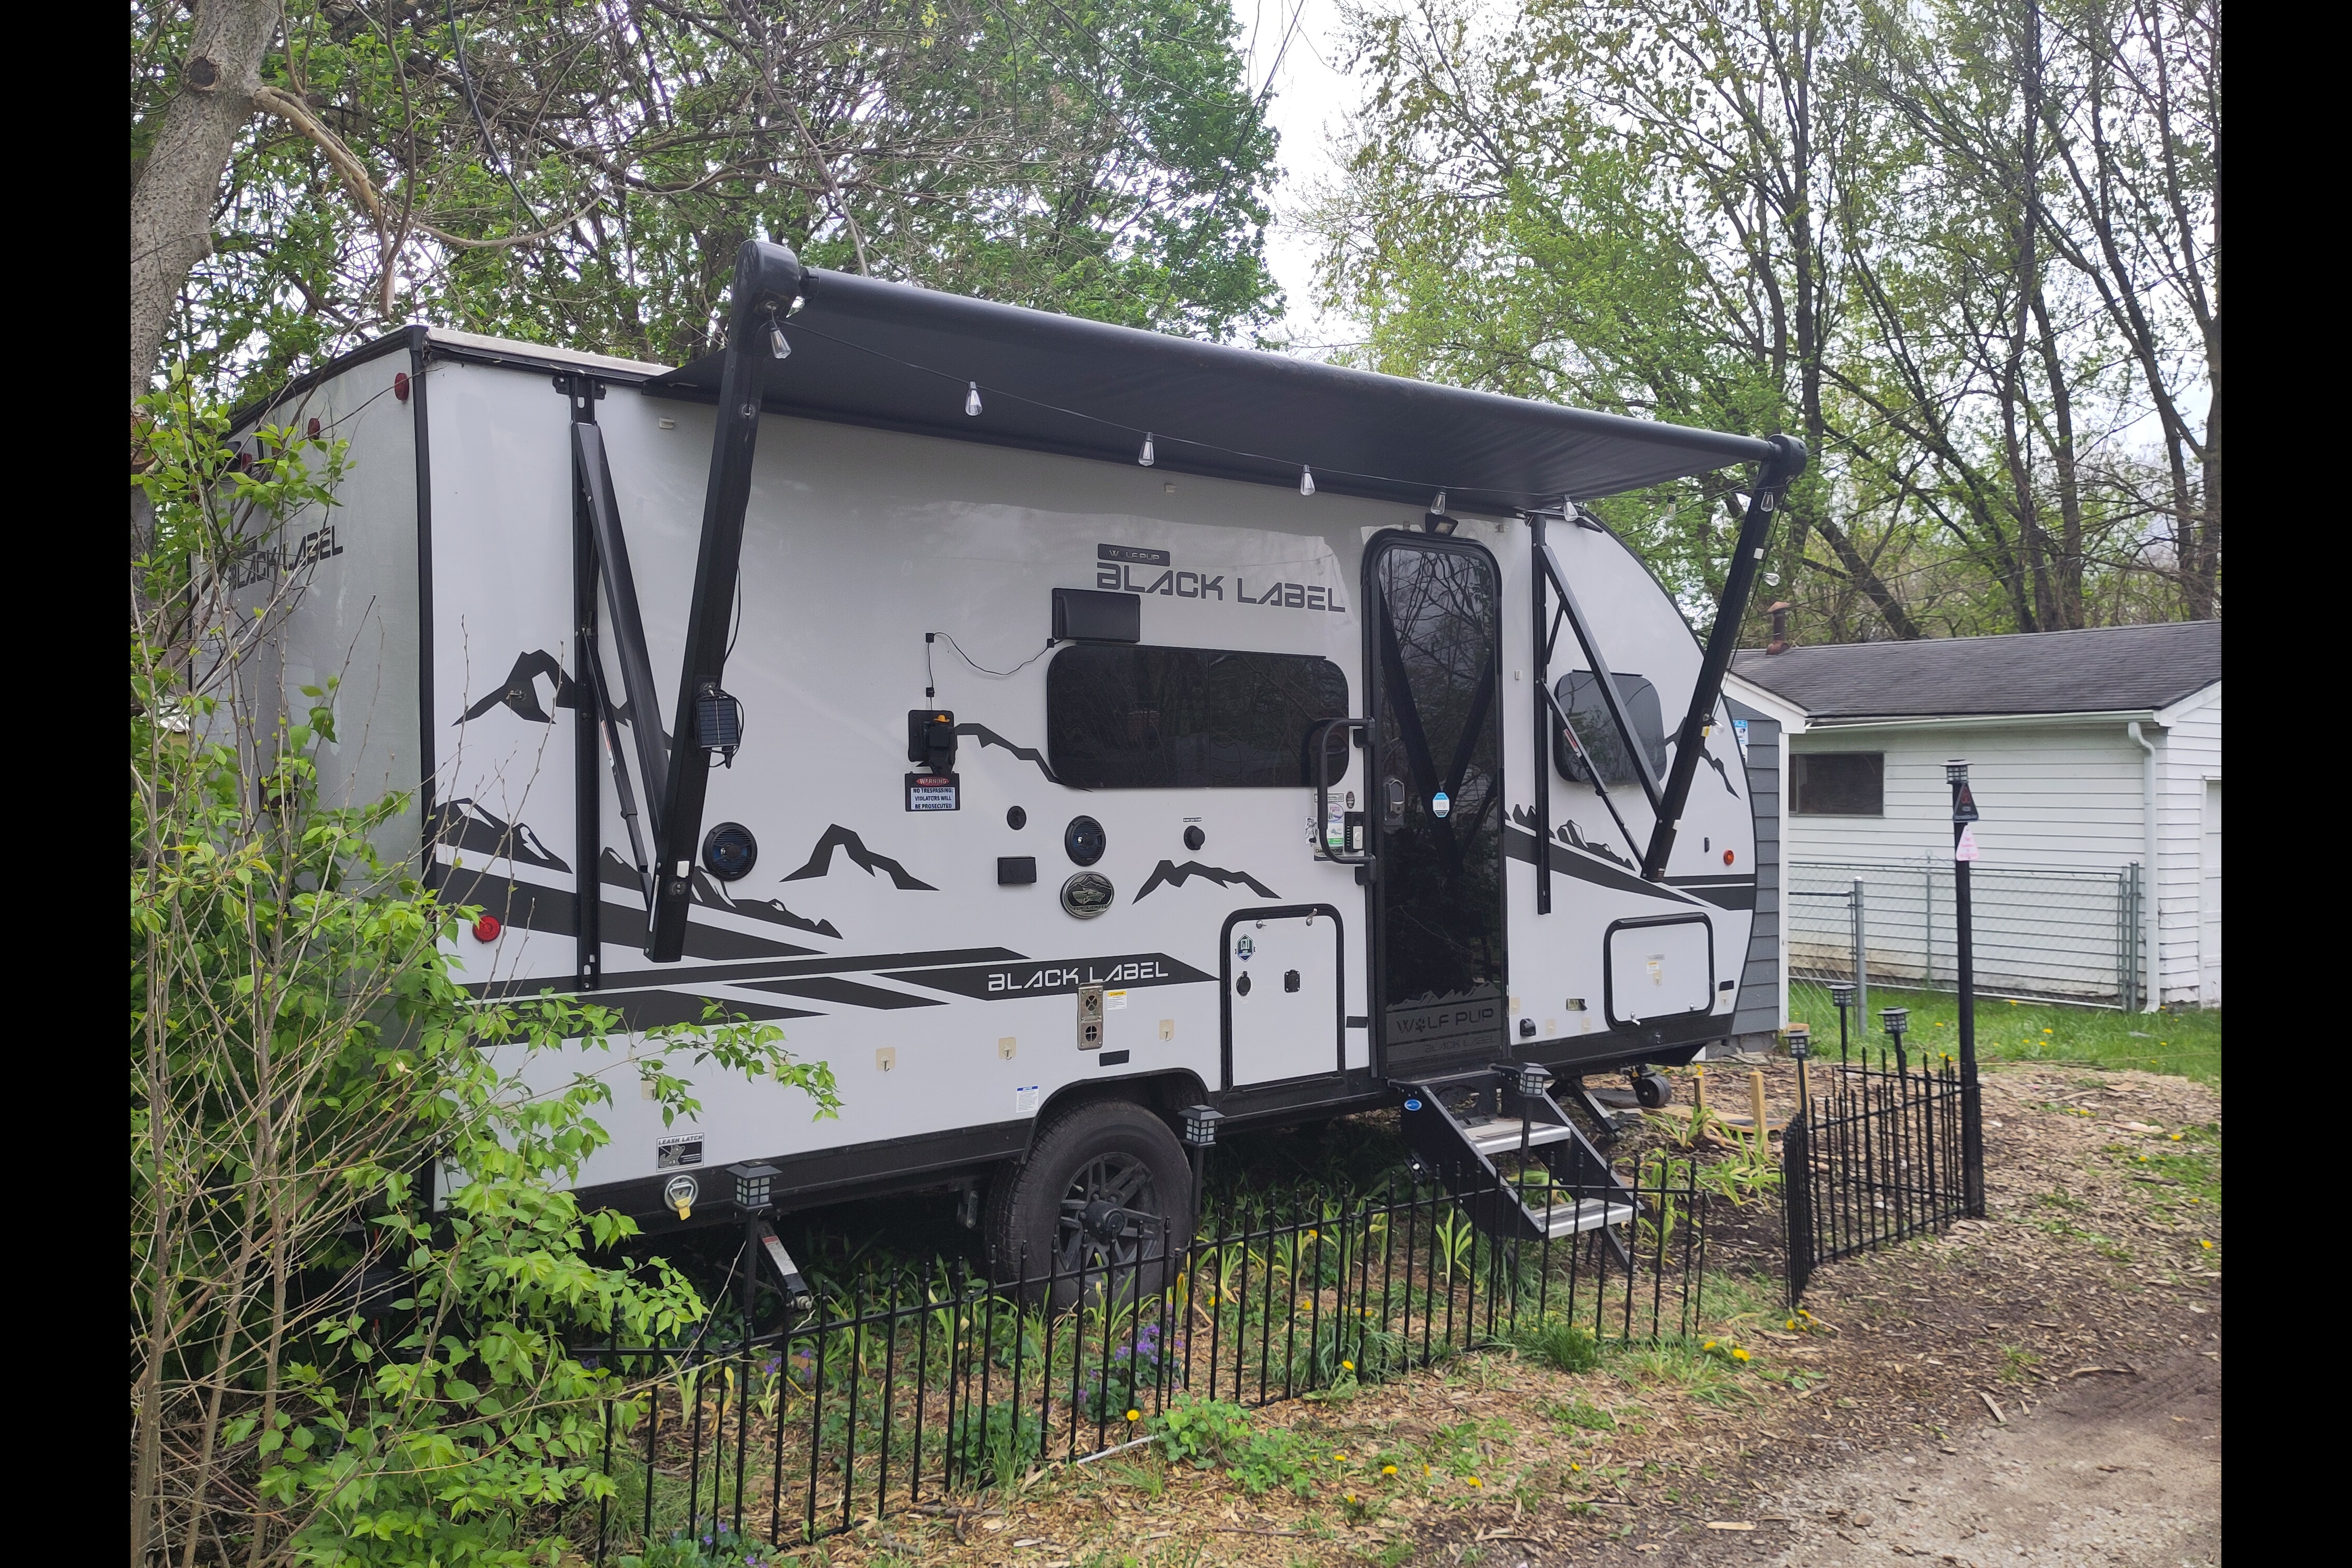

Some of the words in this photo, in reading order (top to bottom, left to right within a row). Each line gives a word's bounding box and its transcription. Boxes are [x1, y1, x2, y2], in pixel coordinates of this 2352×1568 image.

[283, 525, 343, 572] LABEL
[1109, 549, 1138, 558] WLF
[1097, 562, 1225, 601] BLACK
[1237, 578, 1346, 613] LABEL
[988, 967, 1080, 991] BLACK
[1089, 961, 1169, 983] LABEL
[1456, 1008, 1494, 1025] PUP
[1425, 1040, 1460, 1053] BLACK
[1463, 1036, 1496, 1047] LABEL
